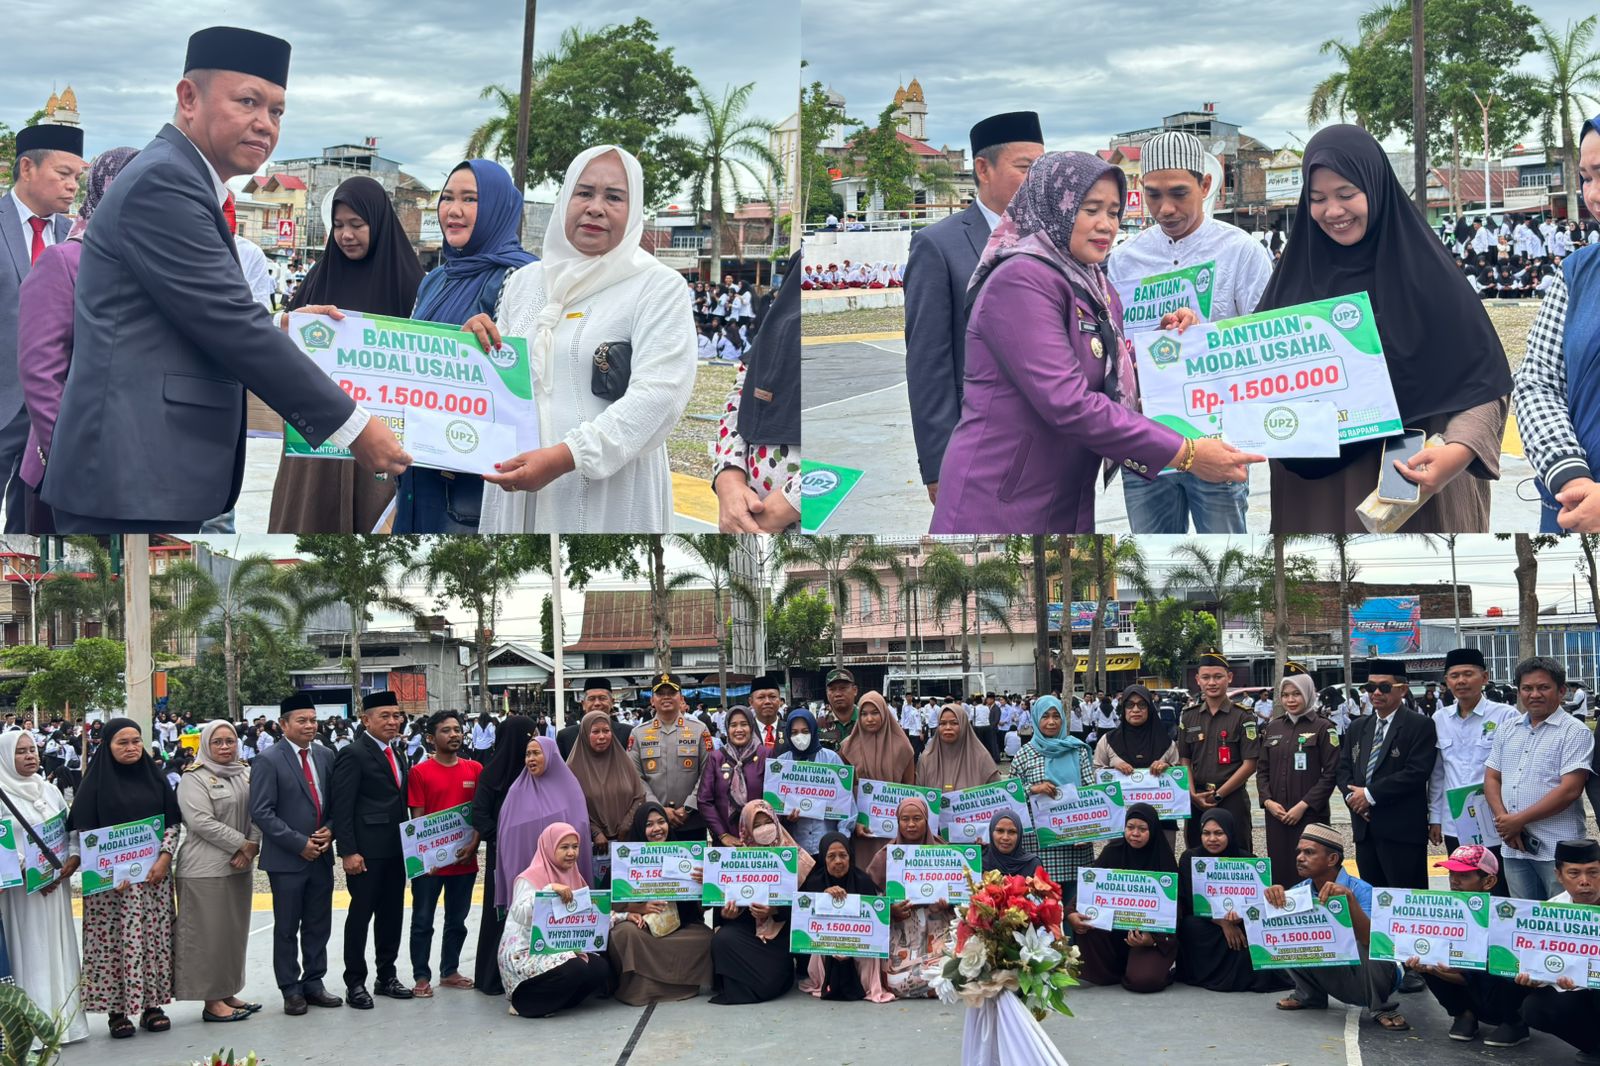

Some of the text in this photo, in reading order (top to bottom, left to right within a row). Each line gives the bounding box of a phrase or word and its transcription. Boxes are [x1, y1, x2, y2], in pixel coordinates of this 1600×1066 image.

[1128, 192, 1139, 206] A
[280, 220, 292, 235] A
[1134, 280, 1181, 302] BANTUAN
[1333, 308, 1359, 323] UPZ
[1206, 316, 1301, 349] BANTUAN
[363, 328, 458, 357] BANTUAN
[491, 349, 515, 361] UPZ
[1186, 333, 1332, 376] MODAL USAHA
[337, 349, 484, 384] MODAL USAHA
[1191, 365, 1339, 413] Rp. 1.500.000
[378, 385, 488, 416] 1.500.000
[1269, 418, 1294, 429] UPZ
[451, 430, 474, 444] UPZ
[801, 476, 835, 489] UPZ
[791, 764, 827, 775] BANTUAN
[781, 772, 835, 785] MODAL USAHA
[780, 785, 835, 798] Rp. 1.500.000
[881, 786, 916, 797] BANTUAN
[959, 787, 995, 801] BANTUAN
[1130, 792, 1172, 801] 1.500.000
[872, 794, 897, 803] MODAL
[952, 795, 1007, 813] MODAL USAHA
[1078, 798, 1106, 808] USAHA
[871, 806, 883, 817] Rp.
[423, 813, 453, 828] BANTUAN
[1052, 817, 1065, 828] Rp.
[1066, 810, 1108, 823] 1.500.000
[108, 825, 145, 840] BANTUAN
[416, 819, 462, 840] MODAL USAHA
[98, 833, 153, 852] MODAL USAHA
[430, 831, 464, 848] 1.500.000
[640, 846, 678, 854] BANTUAN
[731, 851, 769, 860] BANTUAN
[914, 849, 952, 857] BANTUAN
[99, 847, 154, 869] Rp. 1.500.000
[630, 856, 661, 865] MODAL
[720, 860, 779, 869] MODAL USAHA
[904, 858, 962, 867] MODAL USAHA
[1214, 862, 1245, 871] BANTUAN
[630, 869, 644, 881] Rp.
[720, 874, 779, 885] Rp. 1.500.000
[904, 872, 963, 883] Rp. 1.500.000
[1106, 873, 1146, 883] BANTUAN
[1206, 872, 1254, 881] MODAL USAHA
[1095, 882, 1157, 894] MODAL USAHA
[1206, 885, 1256, 896] Rp. 1.500.000
[1095, 895, 1157, 908] Rp. 1.500.000
[1405, 894, 1452, 906] BANTUAN
[1392, 906, 1464, 919] MODAL USAHA
[1532, 906, 1591, 922] BANTUAN
[810, 921, 871, 933] Rp. 1.500.000
[1262, 914, 1328, 928] MODAL USAHA
[1516, 918, 1600, 937] MODAL USAH
[548, 928, 596, 940] MODAL USAHA
[1391, 922, 1464, 937] Rp. 1.500.000
[555, 939, 587, 948] BANTUAN
[1265, 930, 1332, 945] Rp. 1.500.000
[1516, 936, 1600, 956] Rp. 1.500.00
